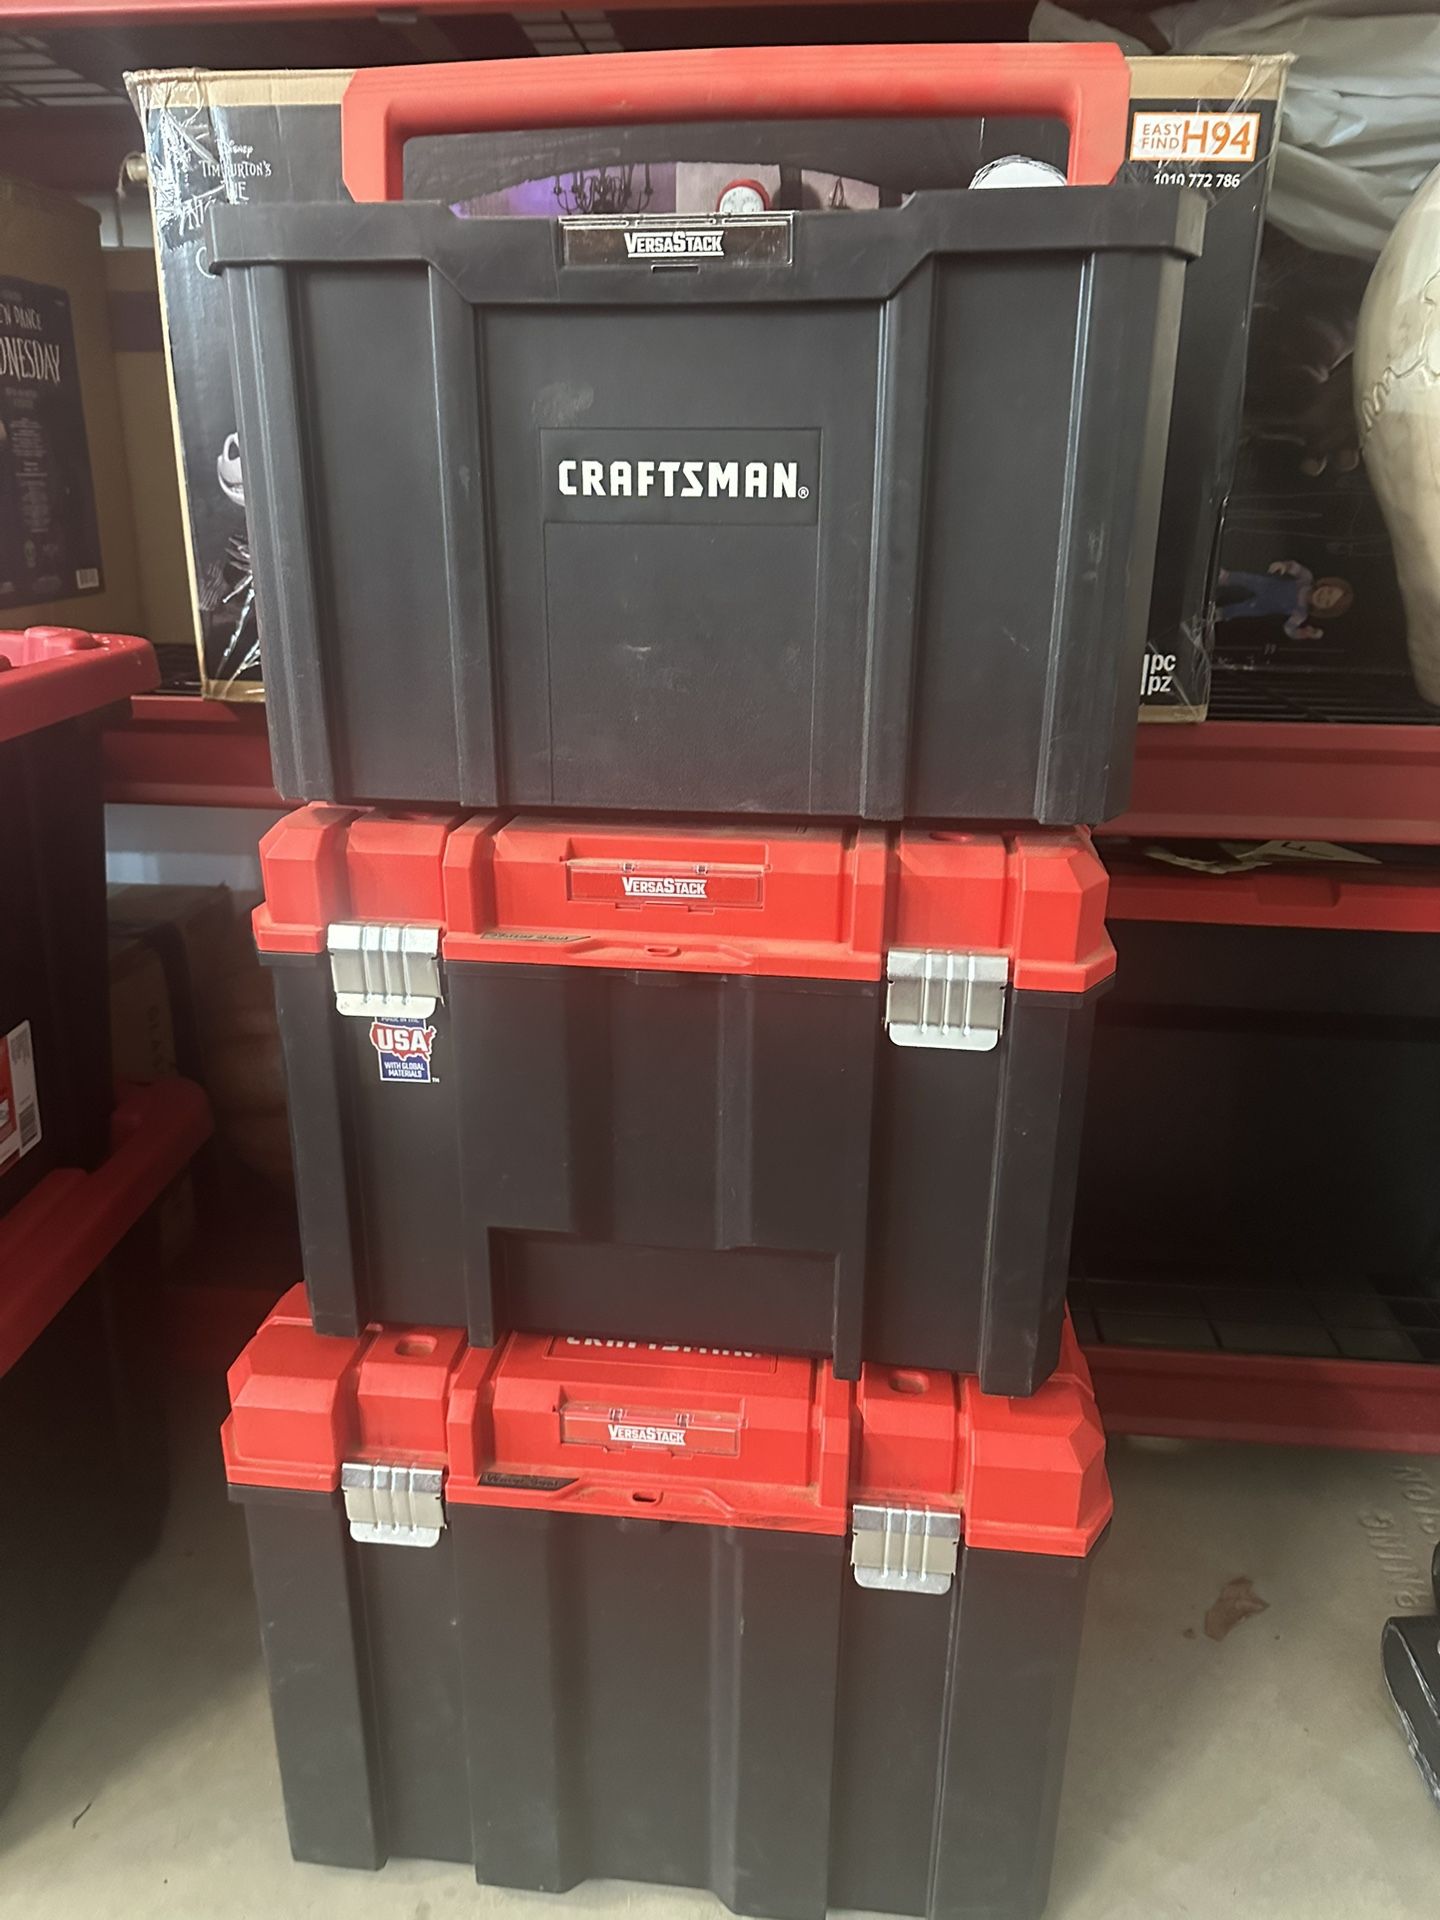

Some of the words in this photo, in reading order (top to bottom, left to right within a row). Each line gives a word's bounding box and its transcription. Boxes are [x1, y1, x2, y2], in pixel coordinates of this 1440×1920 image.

[1142, 123, 1182, 136] EASY
[1181, 119, 1251, 155] H94
[1141, 137, 1180, 150] FIND
[199, 160, 220, 178] TIM
[1153, 172, 1185, 186] 1010
[1188, 173, 1213, 188] 772
[1215, 173, 1241, 188] 786
[13, 305, 42, 331] DANCE
[1150, 654, 1177, 675] pc
[1147, 675, 1172, 696] pz
[376, 1028, 428, 1051] USA
[384, 1061, 402, 1070] WITH
[401, 1062, 425, 1071] GLOBAL
[388, 1069, 422, 1078] MATERIALS
